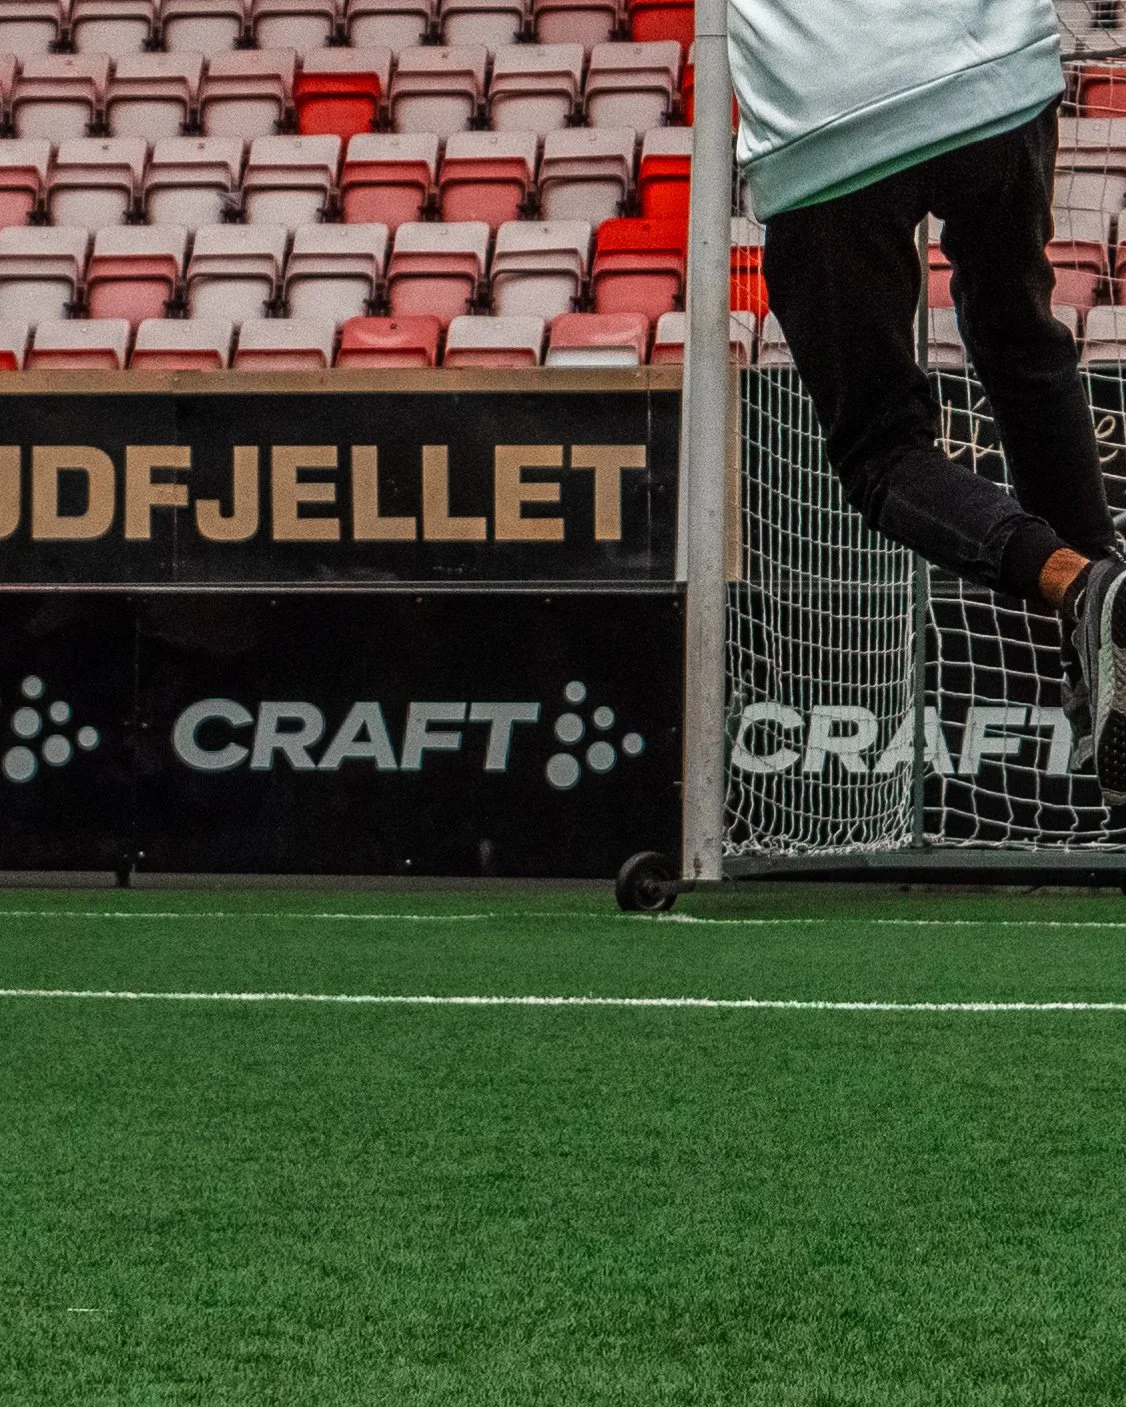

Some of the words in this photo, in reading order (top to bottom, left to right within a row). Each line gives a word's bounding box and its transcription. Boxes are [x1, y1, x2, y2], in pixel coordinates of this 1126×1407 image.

[0, 445, 647, 541] DFJELLET
[172, 698, 541, 771] CRAFT
[731, 702, 1073, 775] CRAFT
